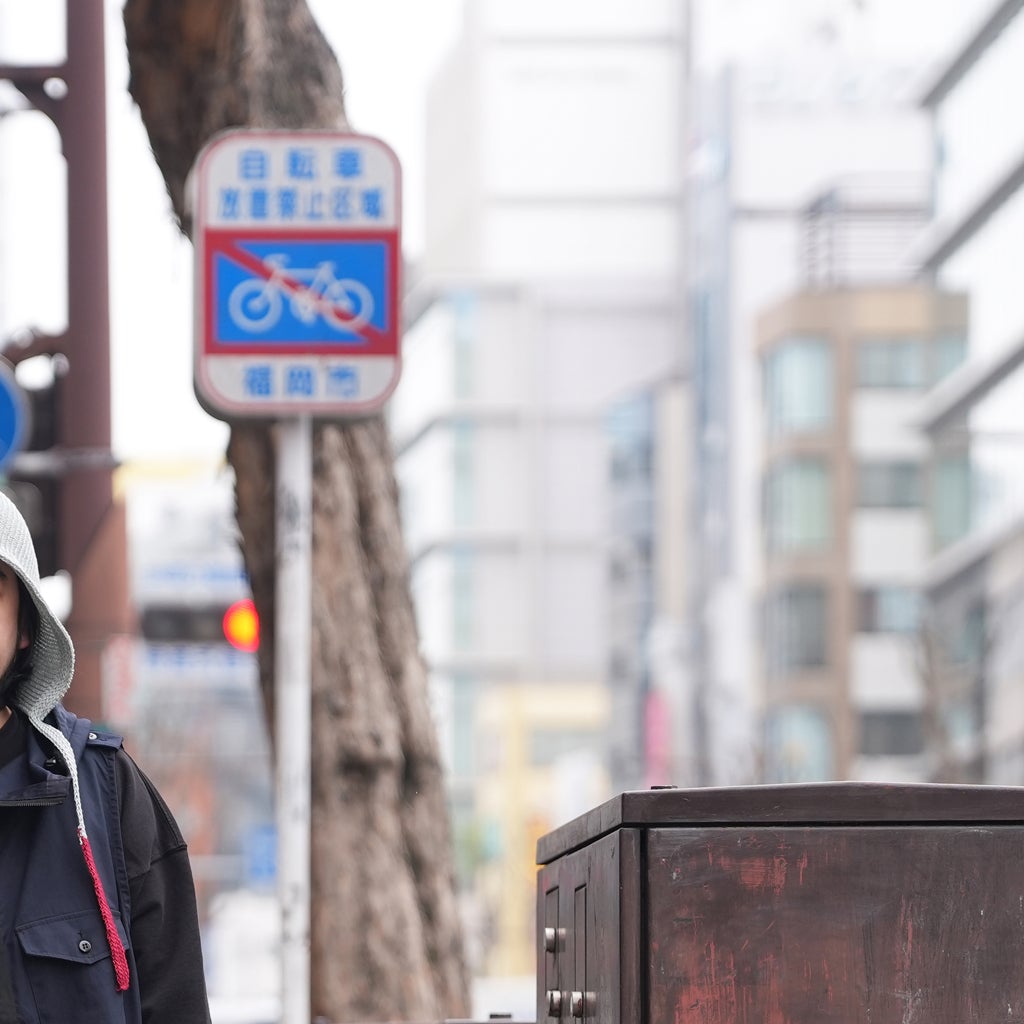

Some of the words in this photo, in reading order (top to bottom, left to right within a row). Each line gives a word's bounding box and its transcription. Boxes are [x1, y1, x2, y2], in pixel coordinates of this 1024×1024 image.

[240, 148, 362, 179] 自転車
[219, 187, 383, 219] 放置禁止区域
[245, 365, 357, 397] 福岡市
